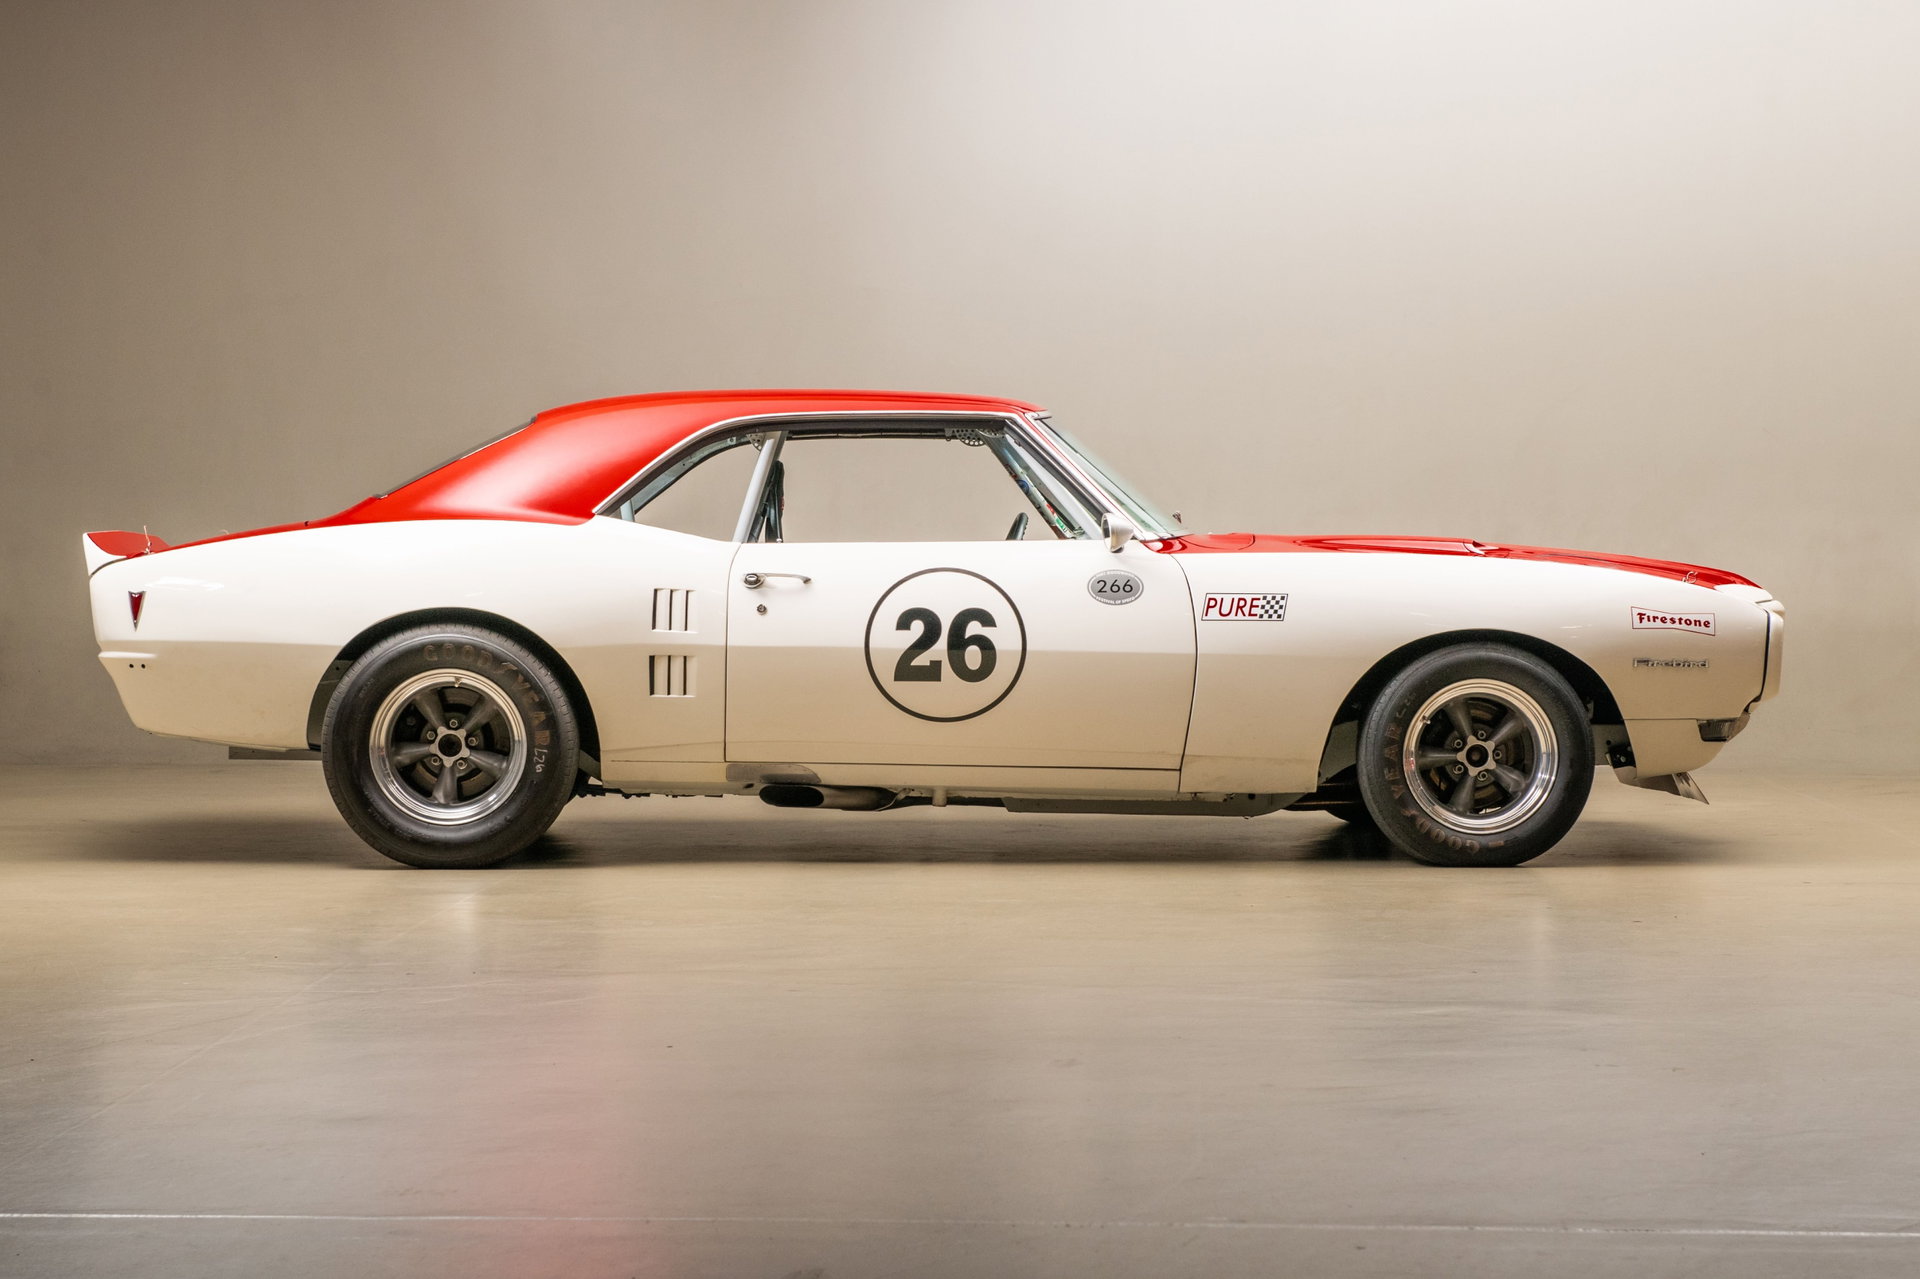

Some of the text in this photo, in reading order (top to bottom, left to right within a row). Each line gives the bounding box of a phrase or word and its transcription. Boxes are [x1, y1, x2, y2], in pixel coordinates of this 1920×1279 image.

[1097, 579, 1133, 593] 266
[1204, 597, 1261, 617] PURE
[1637, 612, 1710, 628] Firestone
[893, 607, 998, 682] 26
